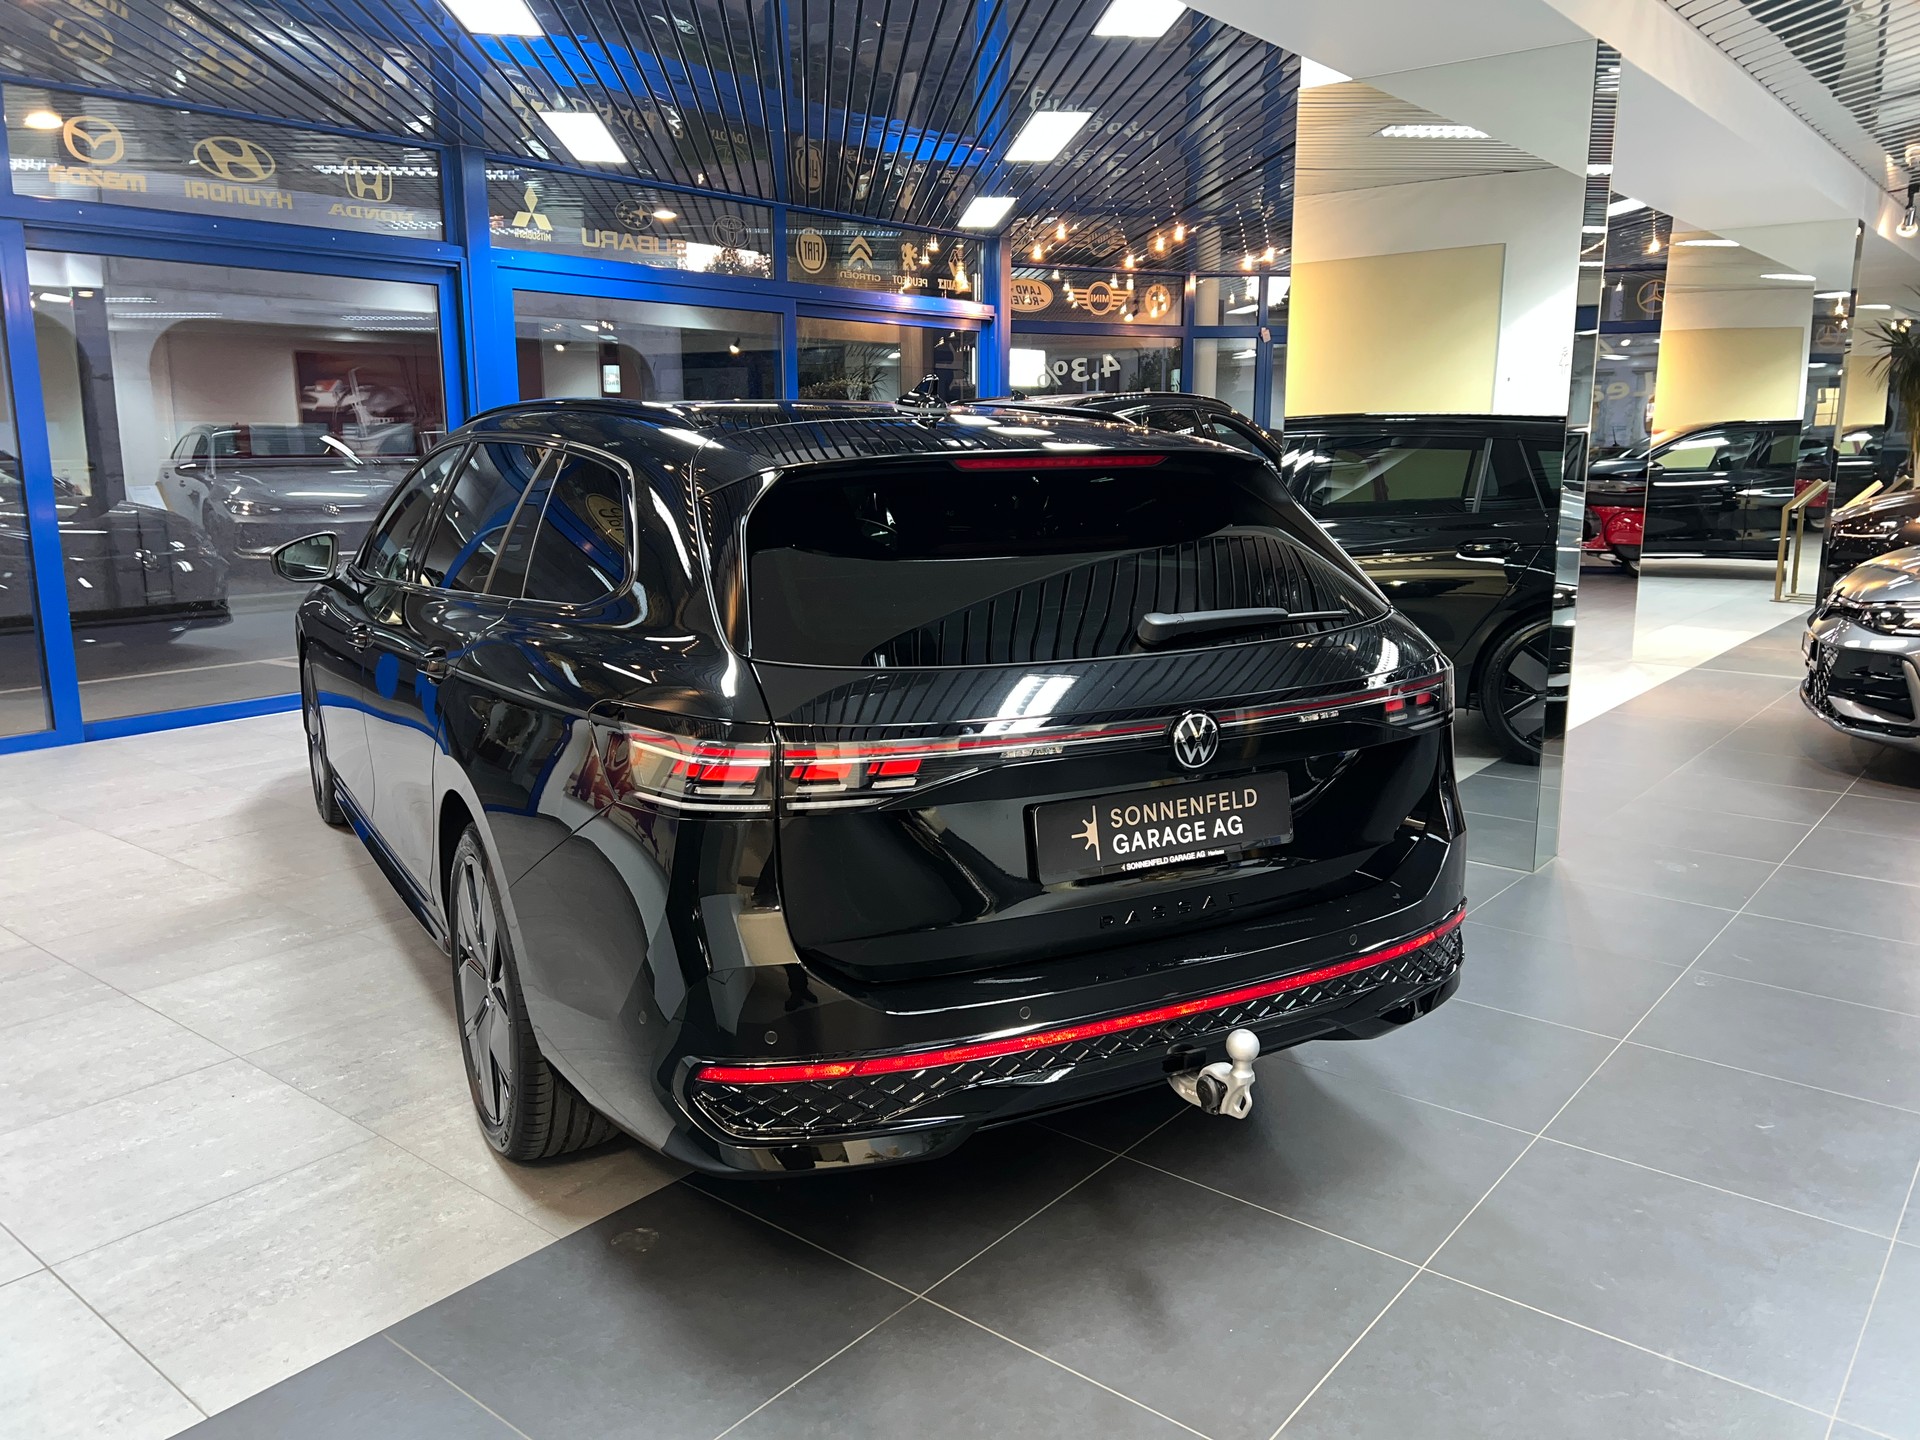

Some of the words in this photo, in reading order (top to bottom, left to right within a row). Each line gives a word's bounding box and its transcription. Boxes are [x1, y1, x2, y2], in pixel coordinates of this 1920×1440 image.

[1110, 788, 1258, 829] SONNENFELD
[1112, 820, 1207, 854] GARAGE
[1213, 815, 1244, 838] AG
[1126, 856, 1169, 871] SONNENFELD
[1169, 852, 1196, 863] GARAGE
[1196, 850, 1206, 859] AG
[1099, 891, 1240, 929] PASSAT
